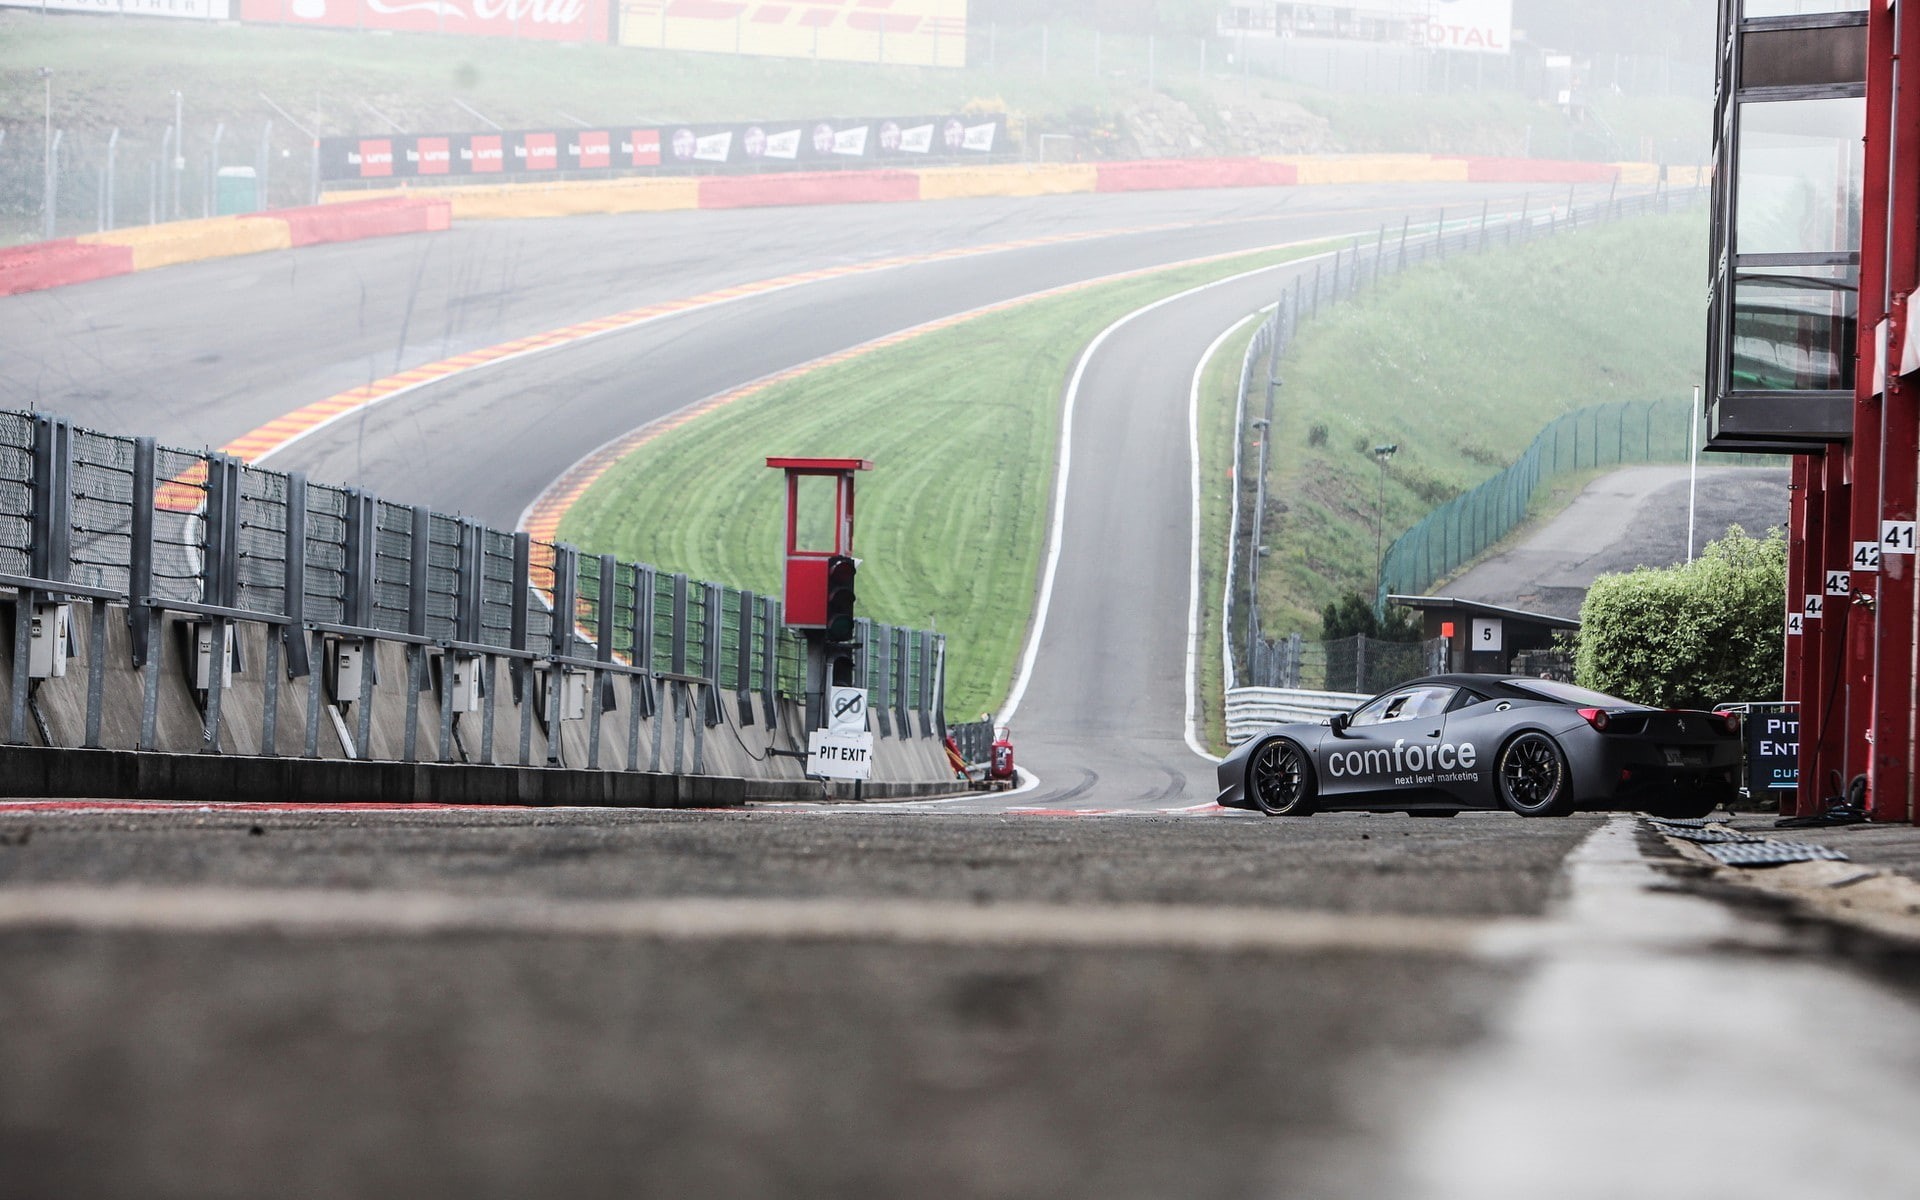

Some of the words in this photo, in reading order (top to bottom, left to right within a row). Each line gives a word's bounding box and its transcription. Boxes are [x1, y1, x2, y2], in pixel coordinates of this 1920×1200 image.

[1411, 16, 1503, 49] TOTAL
[1885, 526, 1913, 548] 41
[1854, 546, 1879, 566] 42
[1826, 575, 1850, 592] 43
[1789, 617, 1803, 631] 4
[1483, 628, 1492, 641] 5
[835, 697, 861, 714] 60
[820, 746, 838, 759] PIT
[841, 747, 867, 762] EXIT
[1329, 738, 1476, 777] comforce
[1395, 775, 1413, 785] next
[1415, 773, 1435, 784] level
[1438, 771, 1479, 783] marketing
